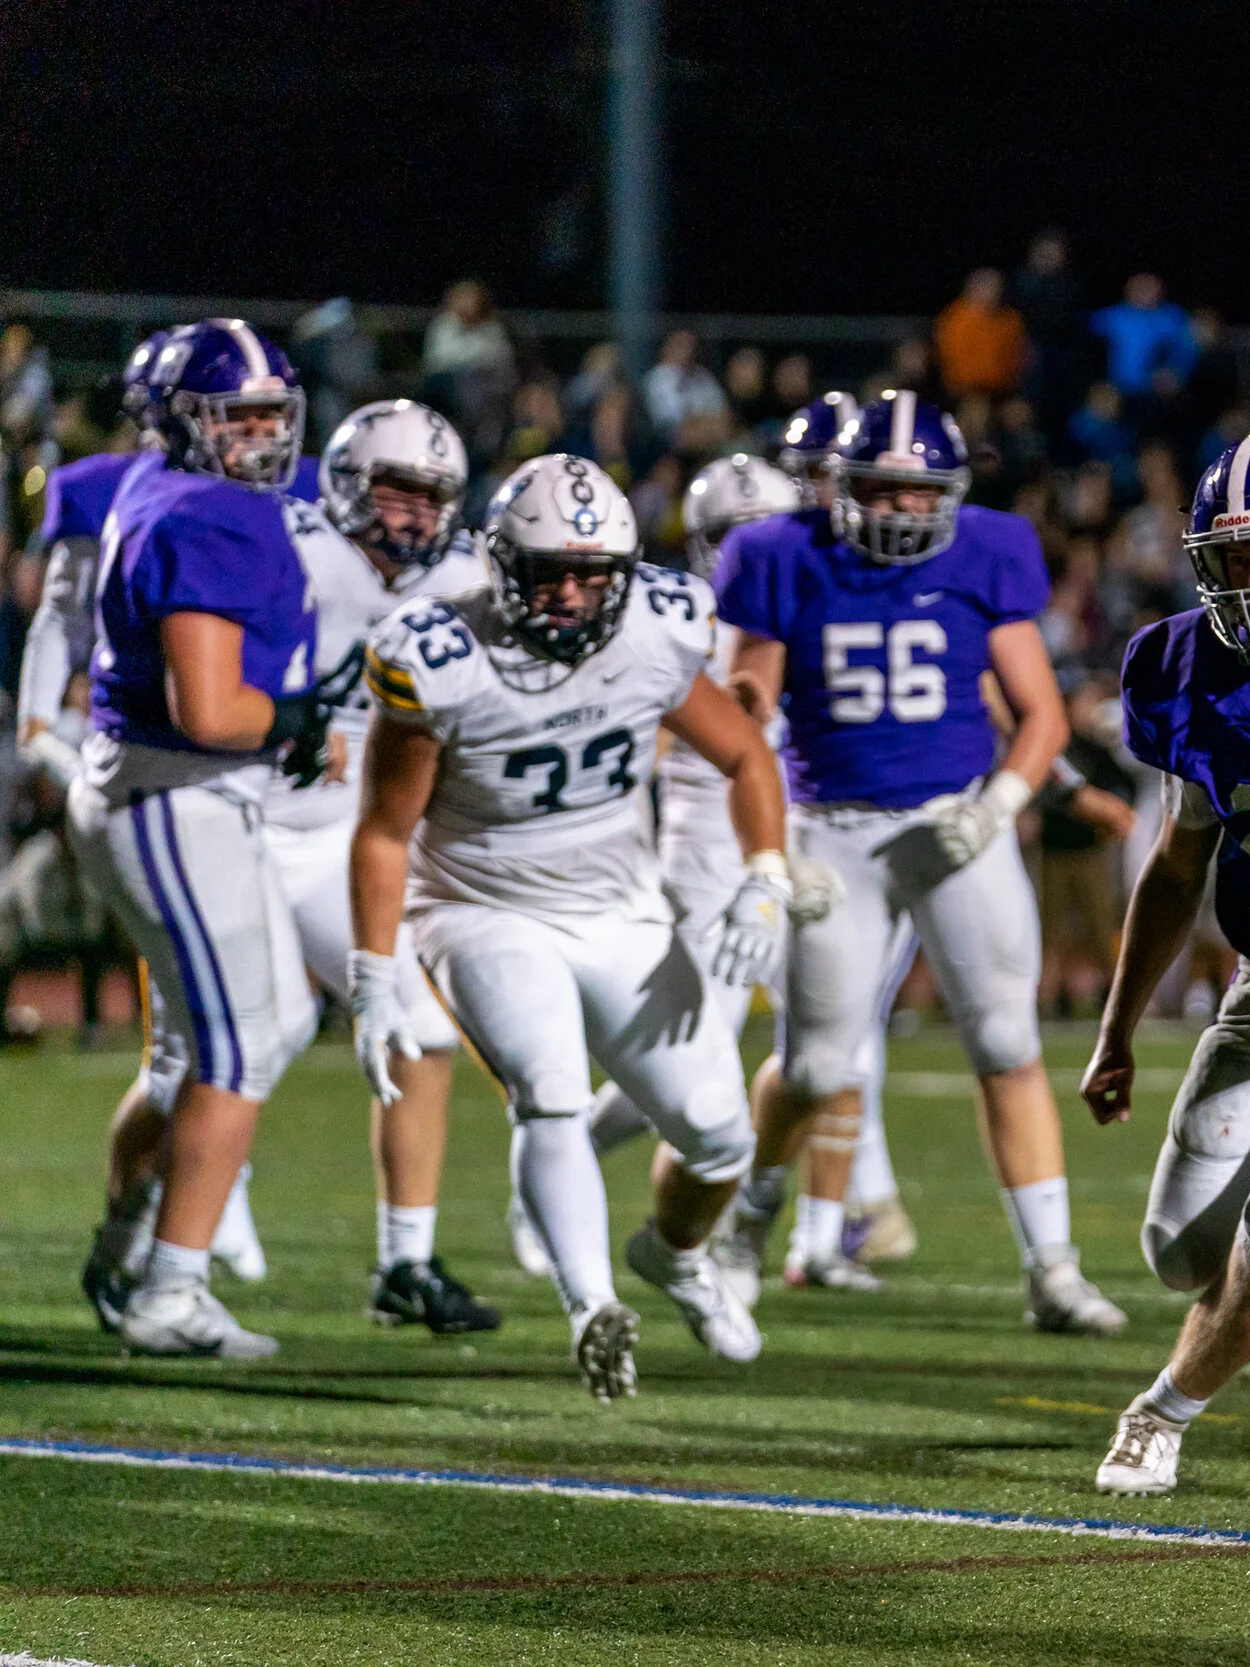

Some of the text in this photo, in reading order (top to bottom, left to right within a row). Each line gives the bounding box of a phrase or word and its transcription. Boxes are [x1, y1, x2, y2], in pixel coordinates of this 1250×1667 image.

[402, 602, 472, 669] 33
[822, 619, 949, 724] 56
[543, 704, 608, 730] NORTH
